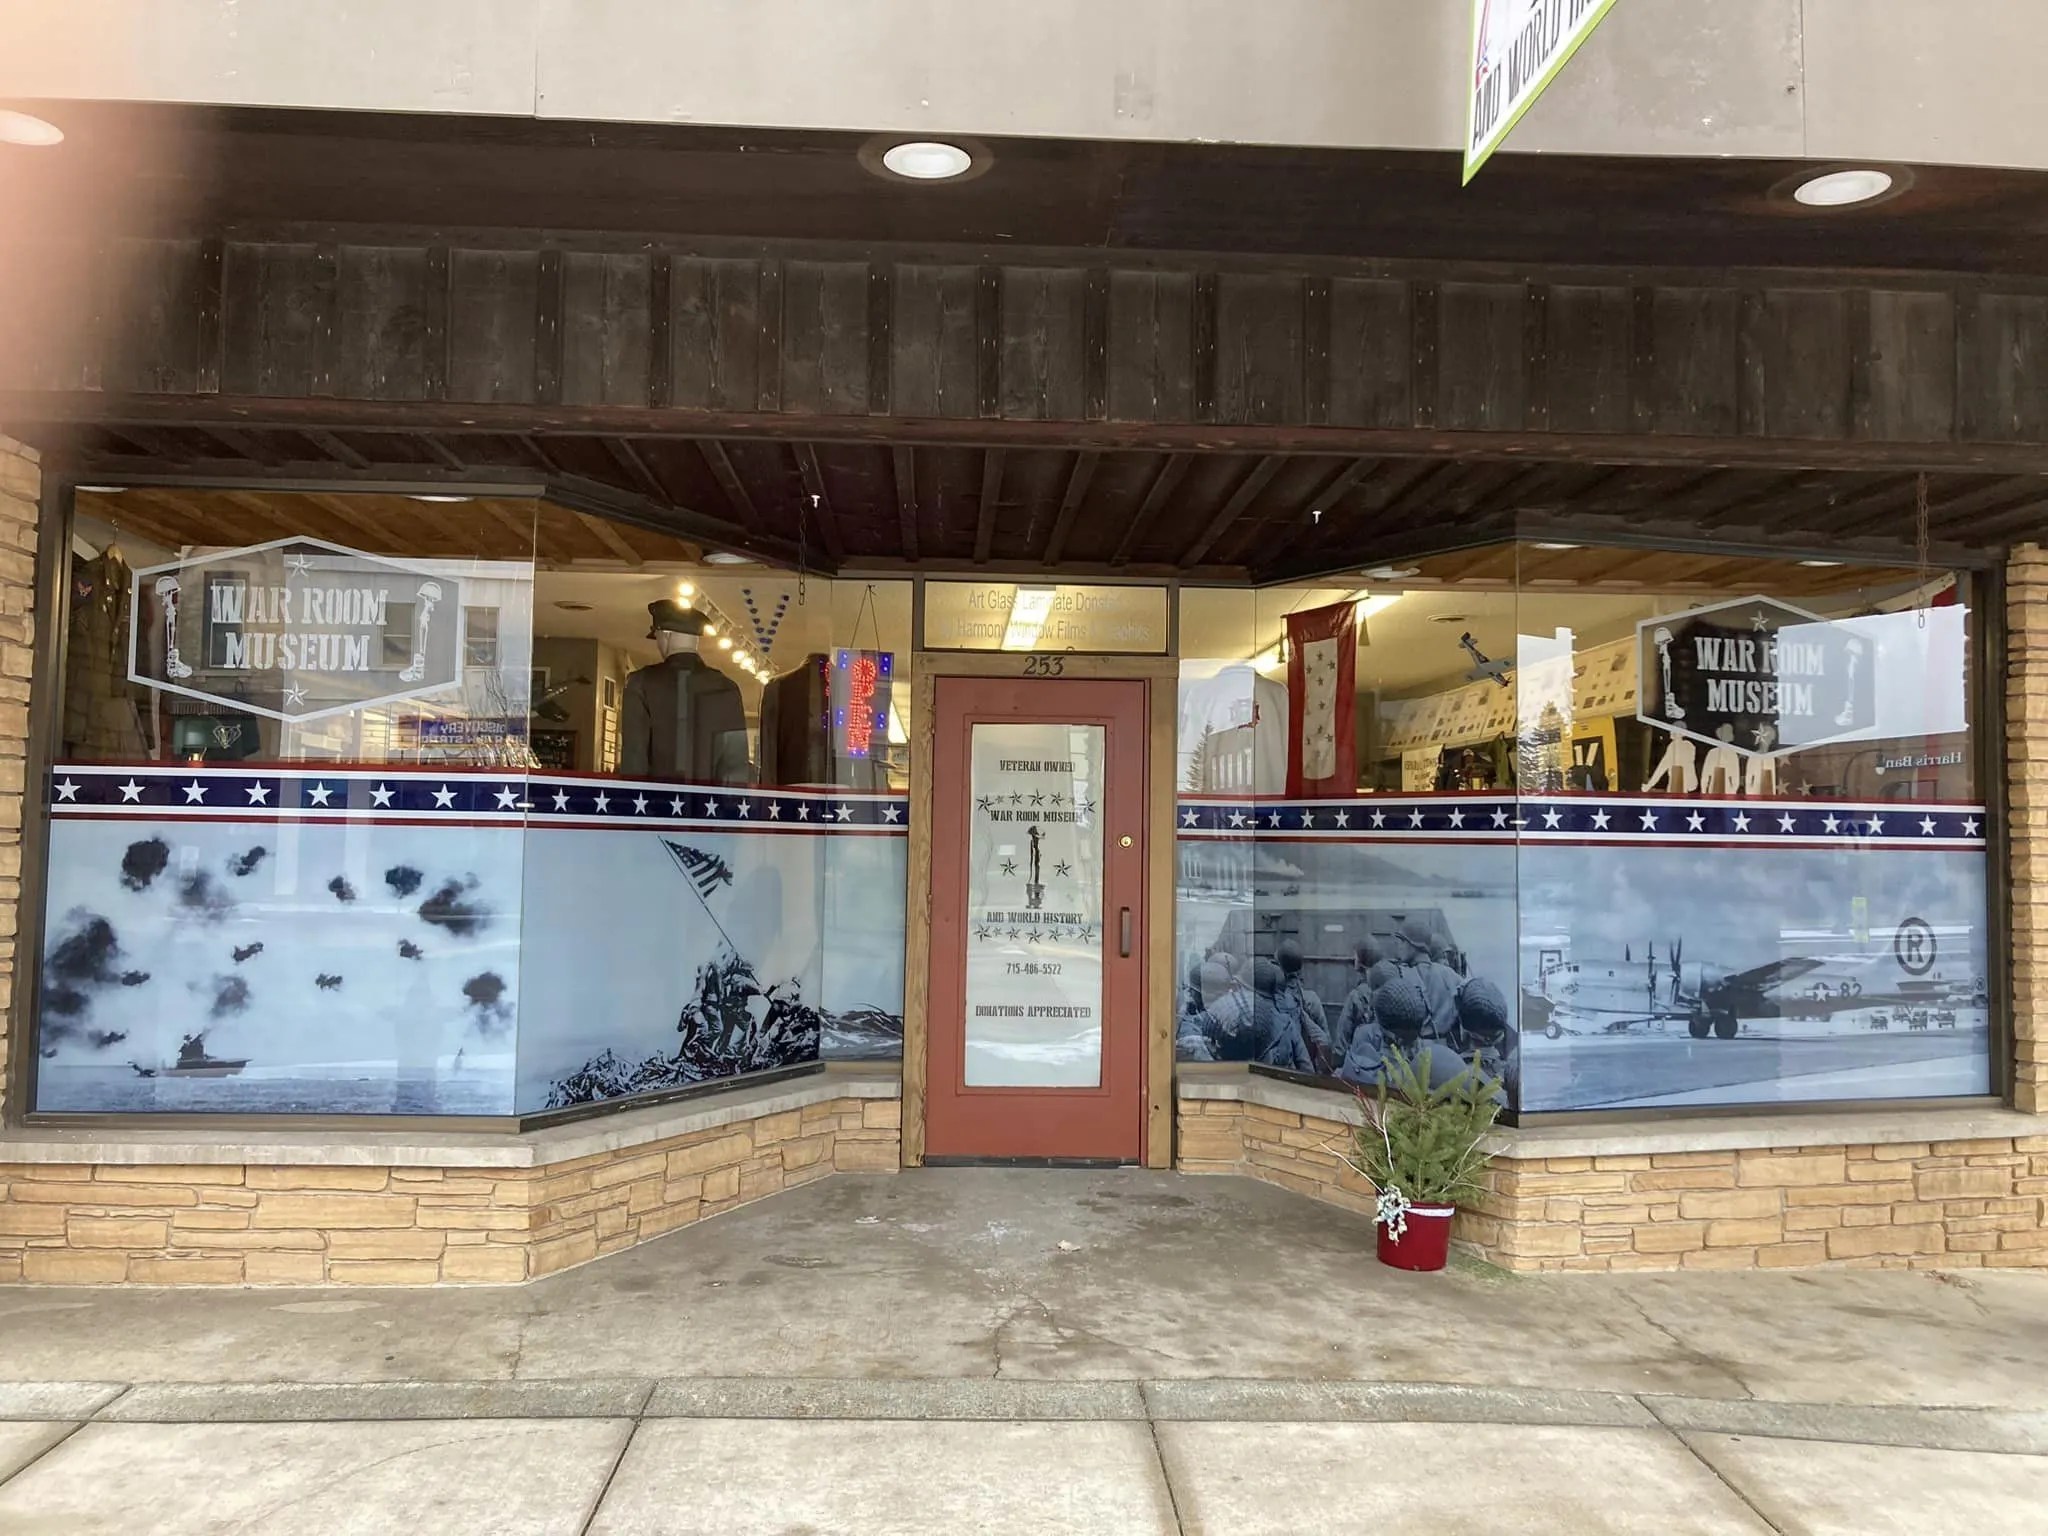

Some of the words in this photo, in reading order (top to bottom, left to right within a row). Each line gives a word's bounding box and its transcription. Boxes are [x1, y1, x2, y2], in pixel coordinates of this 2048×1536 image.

[1472, 63, 1501, 150] AND
[1508, 0, 1561, 104] WORLD
[211, 586, 292, 624] WAR
[302, 587, 389, 625] ROOM
[969, 590, 984, 609] Art
[1057, 620, 1087, 641] Films
[224, 632, 370, 671] MUSEUM
[1694, 637, 1757, 673] WAR
[1761, 640, 1825, 676] ROOM
[1023, 656, 1065, 676] 253
[847, 658, 877, 752] OPEN
[1706, 679, 1814, 716] MUSEUM
[1000, 760, 1041, 772] VETERAN
[990, 810, 1013, 822] WAR
[1016, 810, 1040, 822] ROOM
[1043, 811, 1084, 823] MUSEUM
[986, 912, 1004, 923] AND
[1008, 912, 1040, 924] WORLD
[1044, 912, 1084, 924] HISTORY
[1840, 981, 1862, 999] 82
[975, 1005, 1025, 1017] DONATIONS
[1027, 1005, 1091, 1018] APPRECIATED
